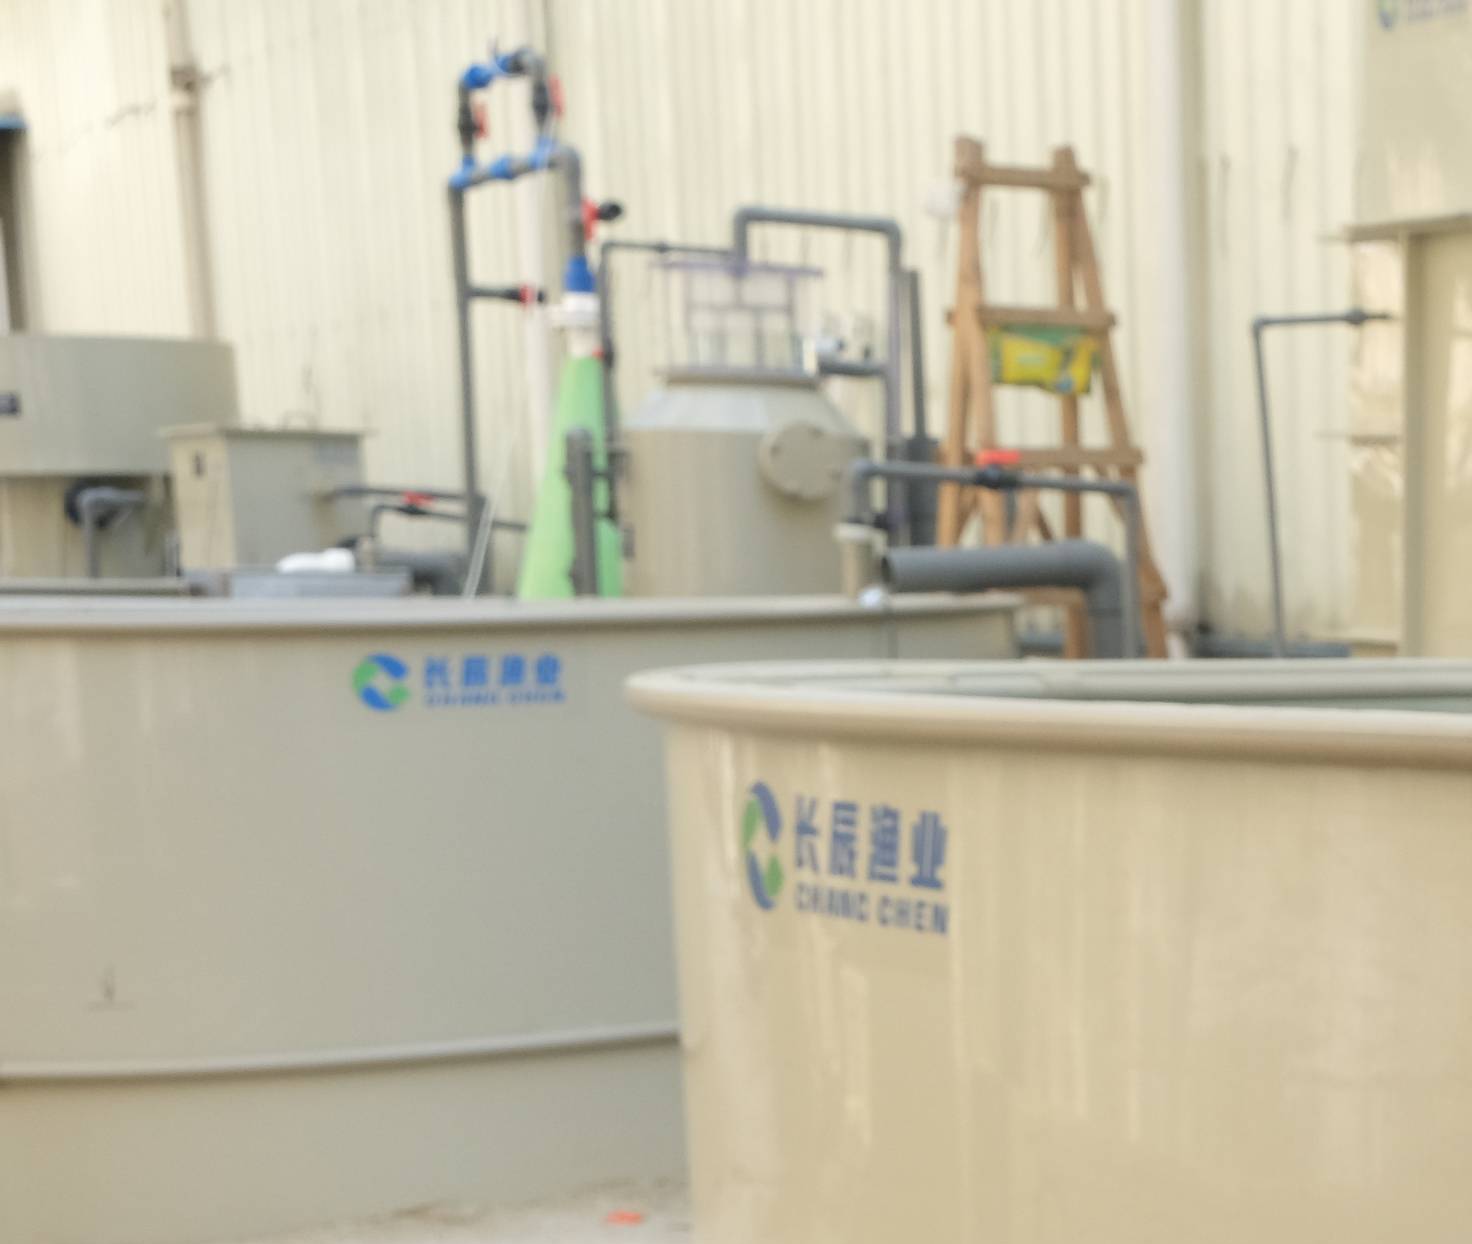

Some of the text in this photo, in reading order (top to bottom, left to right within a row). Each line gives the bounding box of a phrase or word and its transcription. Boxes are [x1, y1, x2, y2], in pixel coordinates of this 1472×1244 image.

[794, 795, 947, 890] 长辰渔业
[878, 894, 950, 934] CHEN
